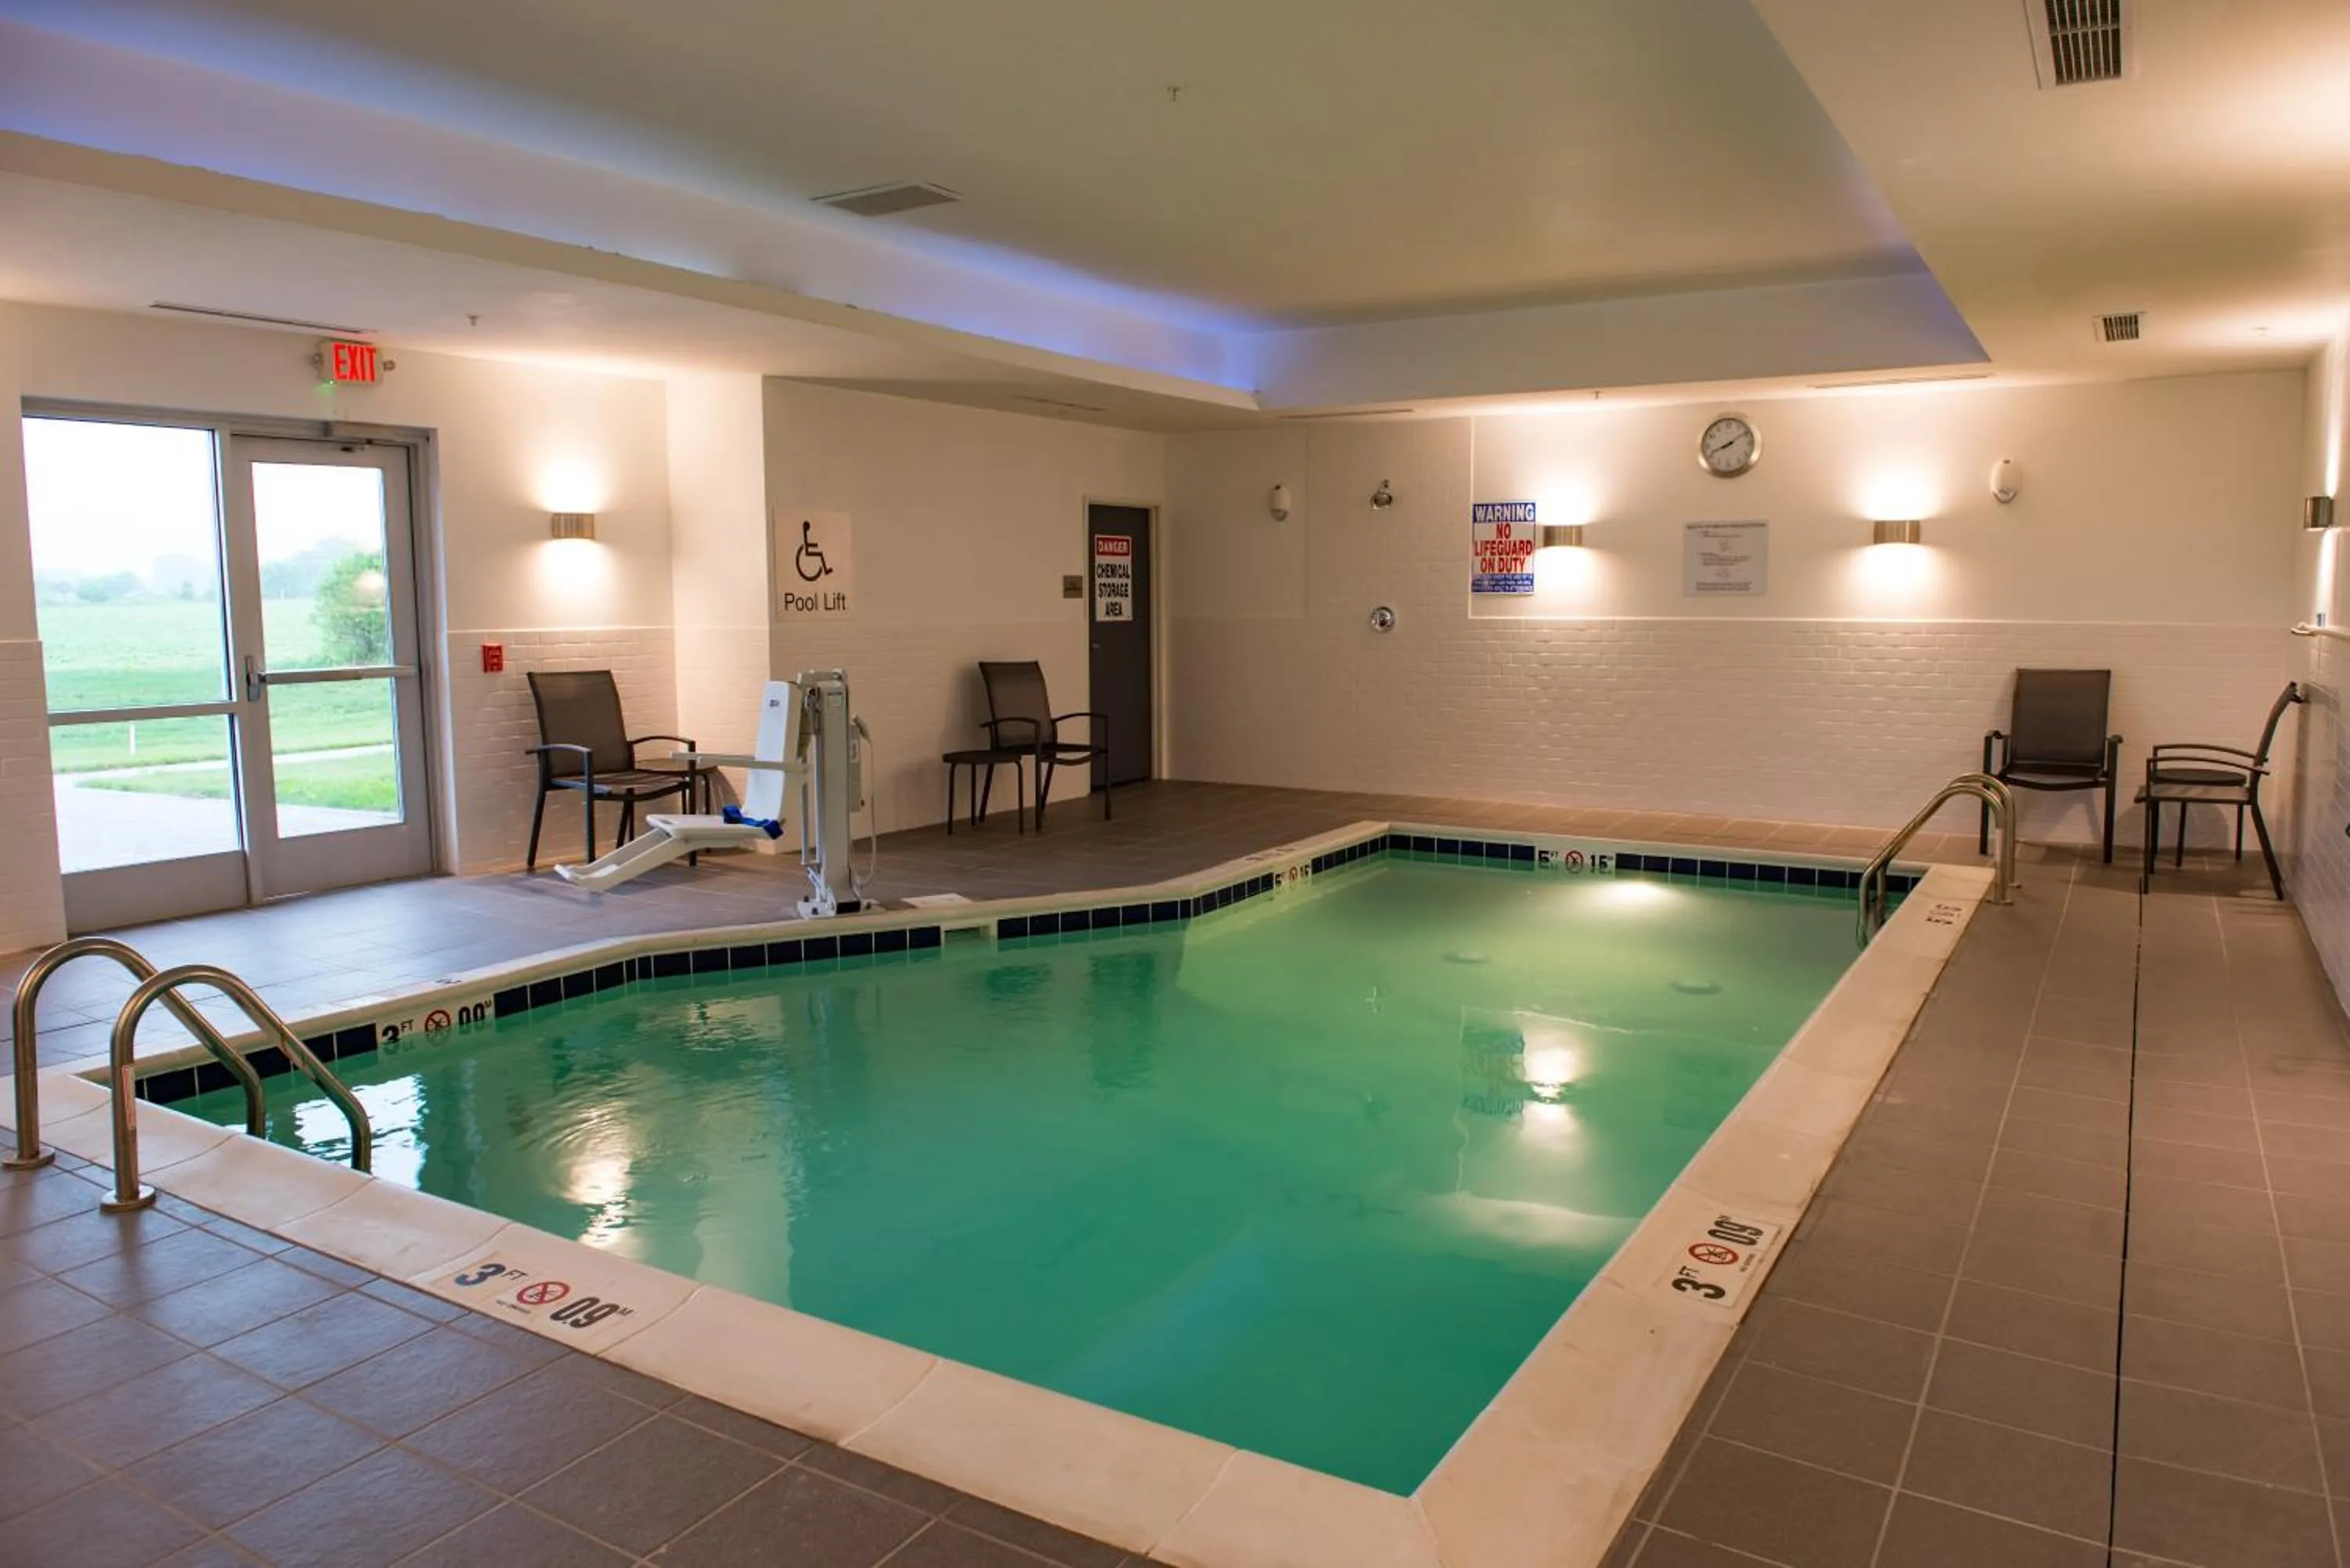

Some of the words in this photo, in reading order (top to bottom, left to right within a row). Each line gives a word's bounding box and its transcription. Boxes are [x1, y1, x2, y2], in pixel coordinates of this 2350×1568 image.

[334, 342, 377, 383] EXIT
[1474, 504, 1535, 522] WARNING
[1496, 523, 1511, 539] NO
[1098, 540, 1129, 553] DANGER
[1474, 540, 1533, 557] LIFEGUARD
[1097, 563, 1130, 579] CHEMICAL
[1480, 557, 1495, 573] ON
[1498, 557, 1526, 573] DUTY
[1097, 582, 1129, 598] STORAGE
[784, 593, 819, 611] Pool
[824, 592, 846, 611] Lift
[1105, 601, 1123, 616] AREA
[454, 1263, 507, 1287] 3
[501, 1269, 529, 1281] FT
[1672, 1277, 1726, 1300] 3
